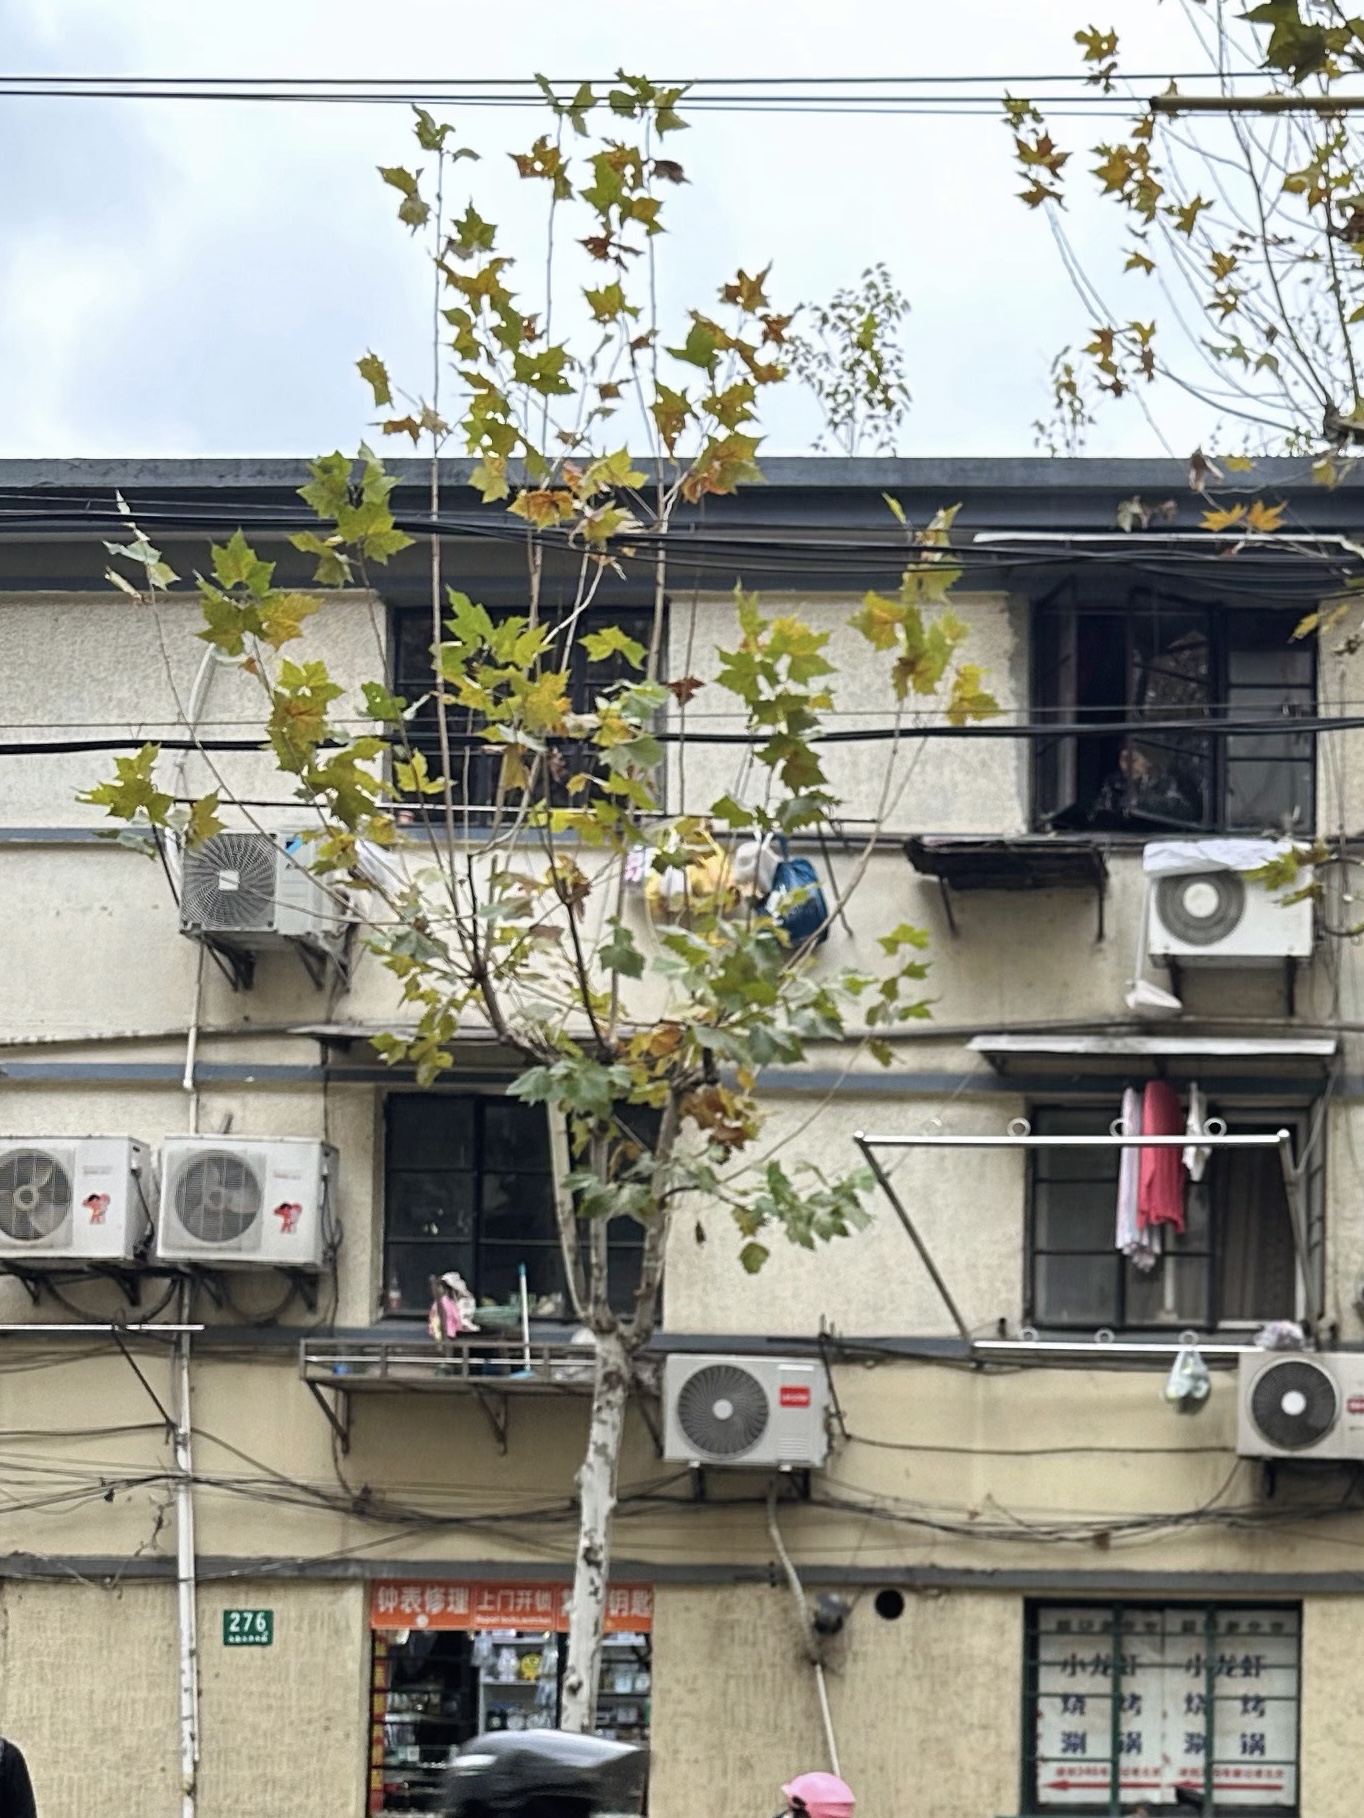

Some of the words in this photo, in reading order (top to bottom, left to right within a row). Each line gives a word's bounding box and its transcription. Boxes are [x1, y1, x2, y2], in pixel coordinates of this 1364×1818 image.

[378, 1585, 469, 1614] 钟表修理
[475, 1588, 552, 1613] 上门开锁
[229, 1611, 267, 1632] 276
